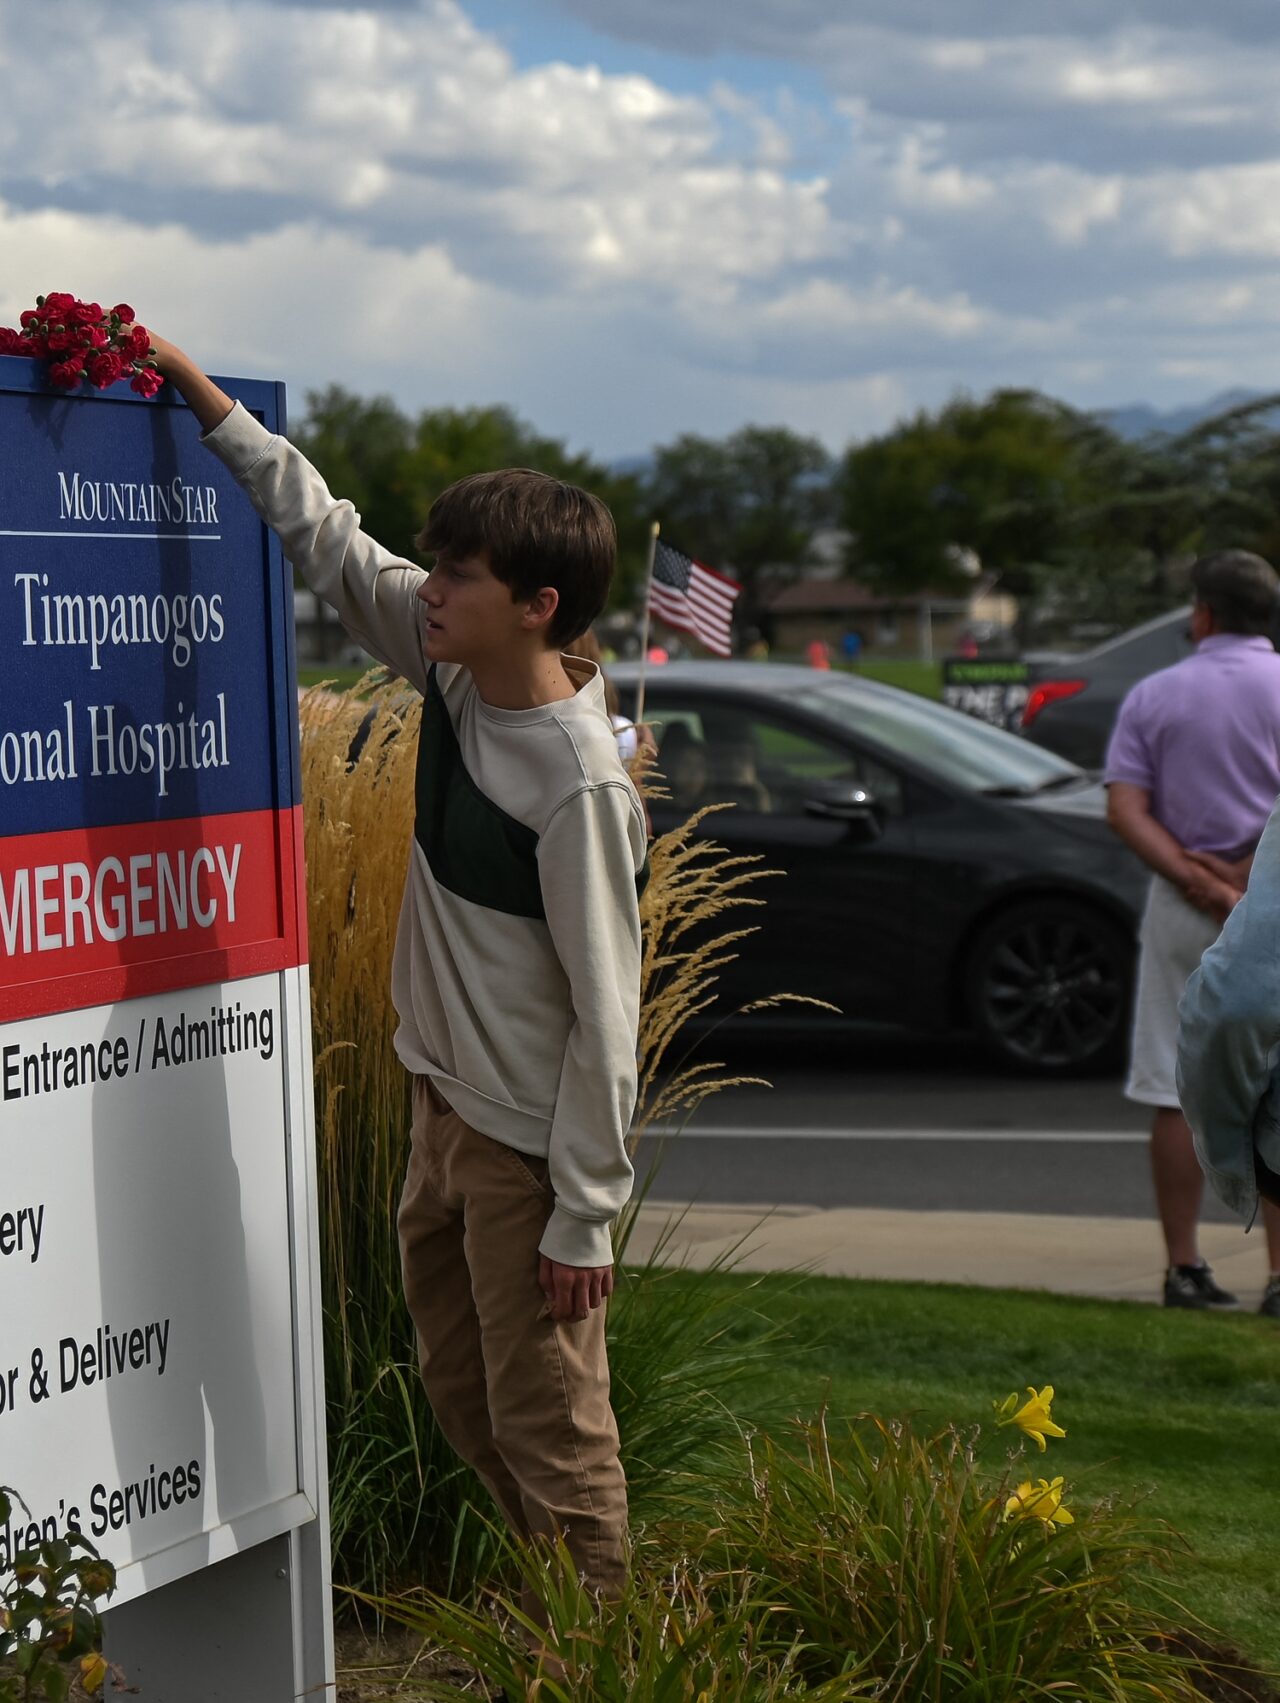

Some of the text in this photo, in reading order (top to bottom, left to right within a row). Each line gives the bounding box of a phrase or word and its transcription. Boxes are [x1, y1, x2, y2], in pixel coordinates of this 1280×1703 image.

[14, 573, 225, 670] Timpanogos
[87, 692, 230, 796] Hospital
[3, 1032, 129, 1101] Entrance
[135, 1019, 145, 1073] /
[152, 1002, 274, 1070] Admitting
[29, 1347, 50, 1403] &
[59, 1319, 170, 1393] Delivery
[90, 1460, 201, 1537] Services
